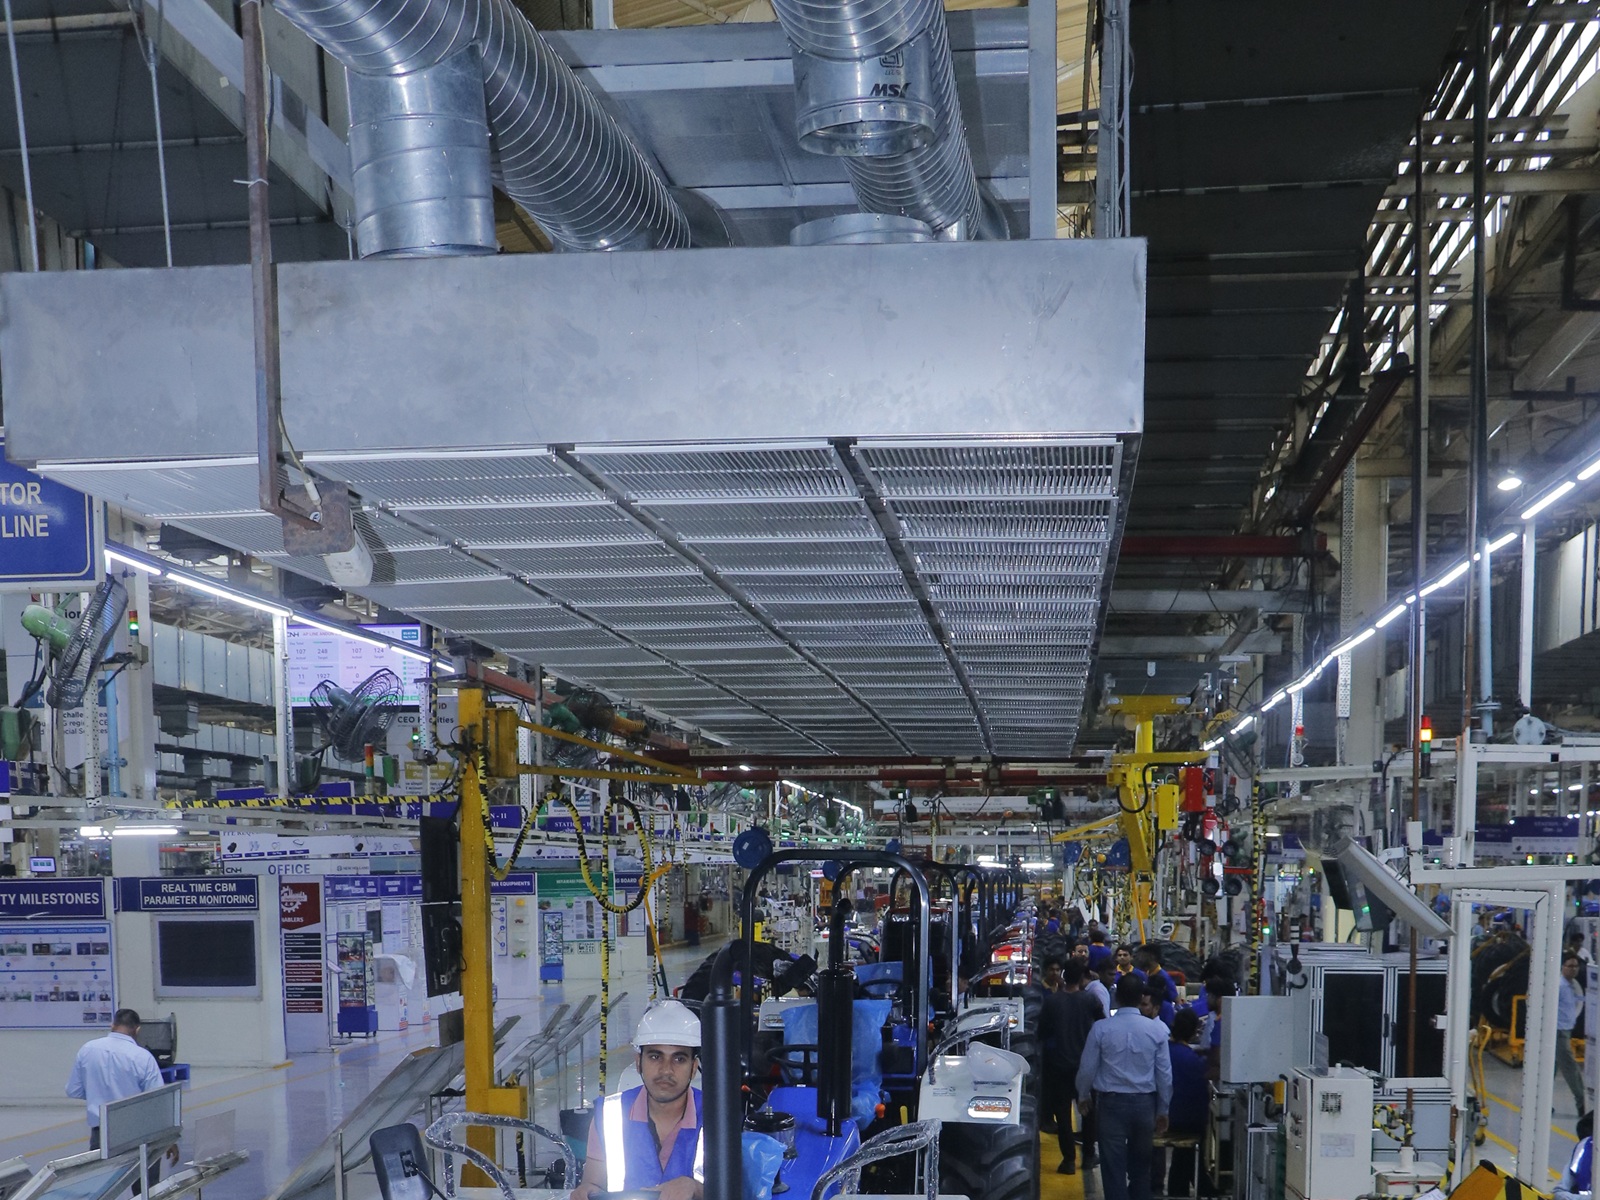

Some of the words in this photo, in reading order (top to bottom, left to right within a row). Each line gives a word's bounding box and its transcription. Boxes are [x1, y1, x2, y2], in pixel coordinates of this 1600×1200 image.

[1, 514, 49, 538] LINE
[397, 716, 415, 724] CEO
[267, 864, 310, 875] OFFICE
[161, 883, 187, 893] REAL
[189, 883, 212, 893] TIME
[214, 882, 237, 892] CBM
[20, 892, 100, 905] MILESTONES
[144, 895, 197, 905] PARAMETER
[199, 894, 255, 904] MONITORING
